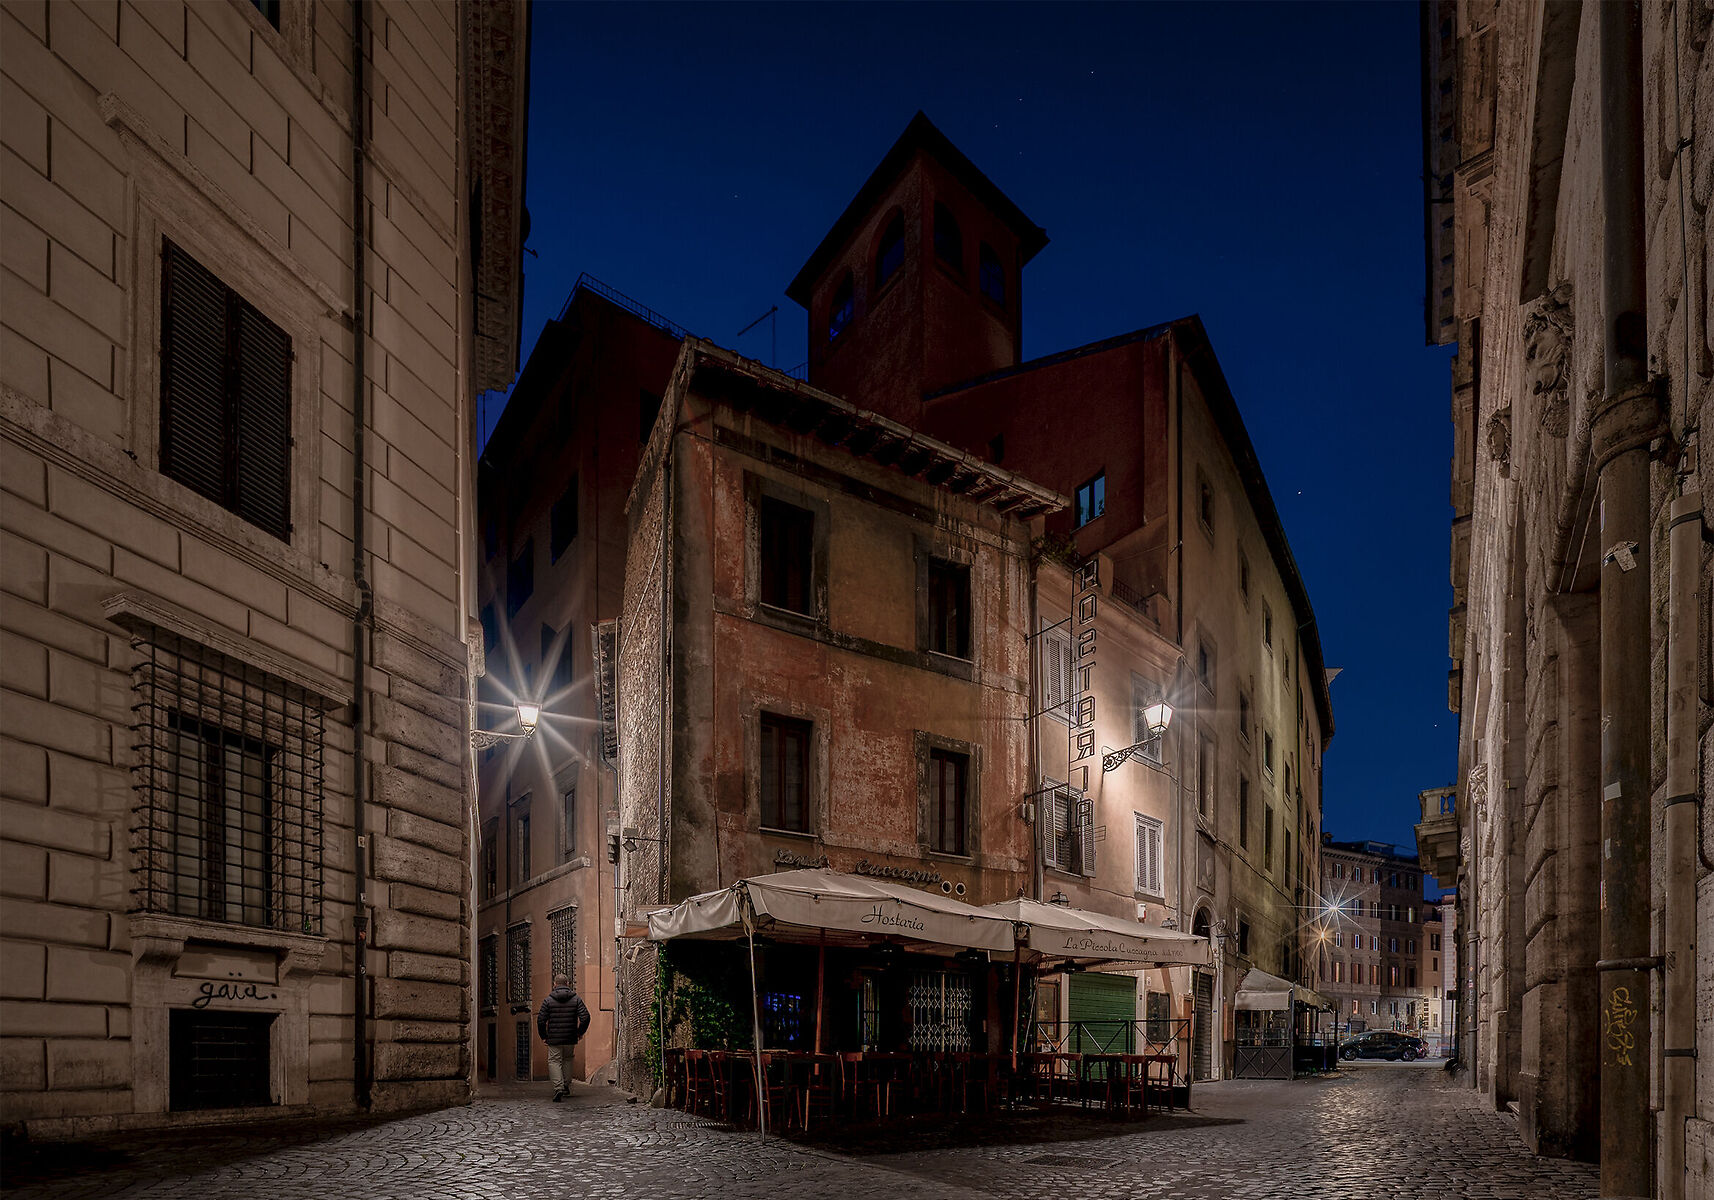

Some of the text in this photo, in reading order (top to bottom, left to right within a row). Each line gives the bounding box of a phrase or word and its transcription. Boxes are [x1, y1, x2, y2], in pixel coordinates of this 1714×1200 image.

[861, 904, 924, 931] Hostaria
[1062, 936, 1078, 950] La
[1080, 938, 1118, 952] Piccola
[1119, 942, 1158, 960] Cuccagna
